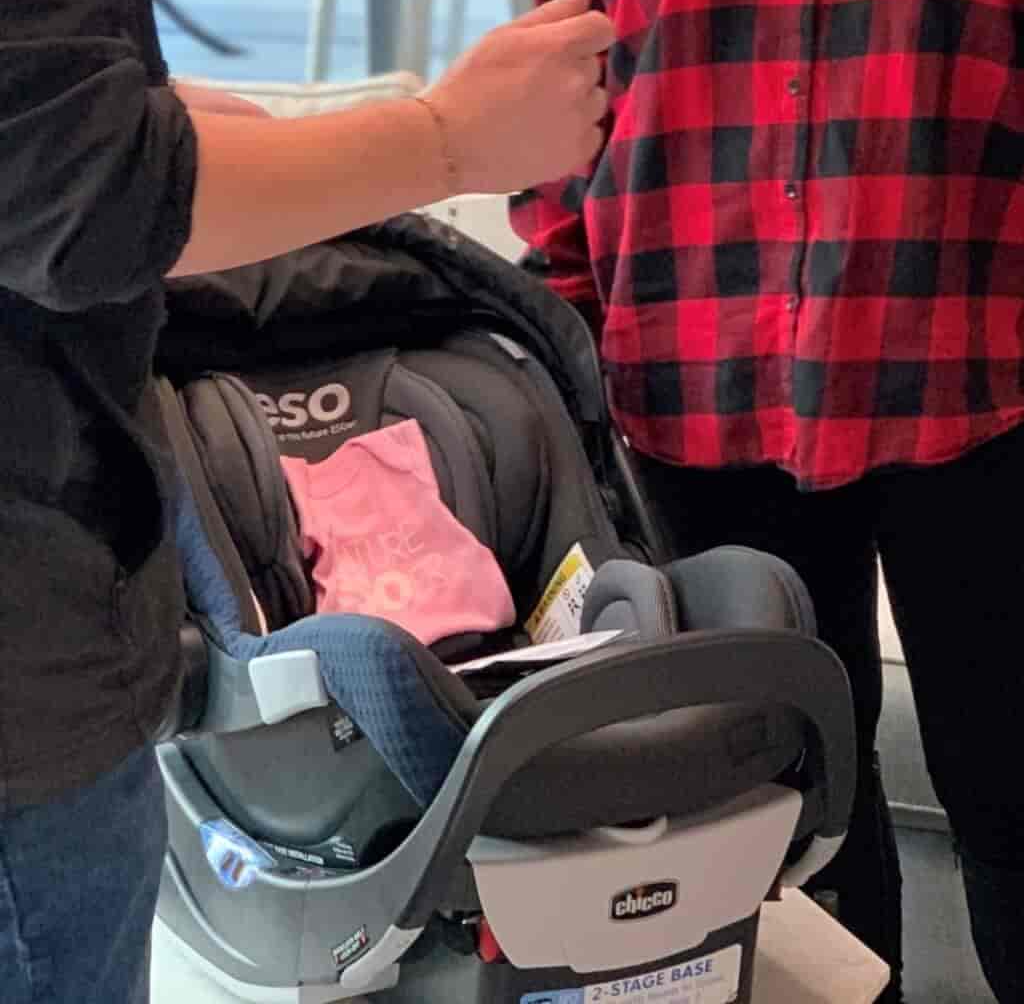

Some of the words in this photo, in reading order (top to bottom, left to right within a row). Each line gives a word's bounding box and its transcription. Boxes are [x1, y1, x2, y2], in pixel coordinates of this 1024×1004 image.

[615, 890, 673, 916] chicco
[592, 973, 665, 1001] 2-STAGE
[671, 959, 713, 982] BASE
